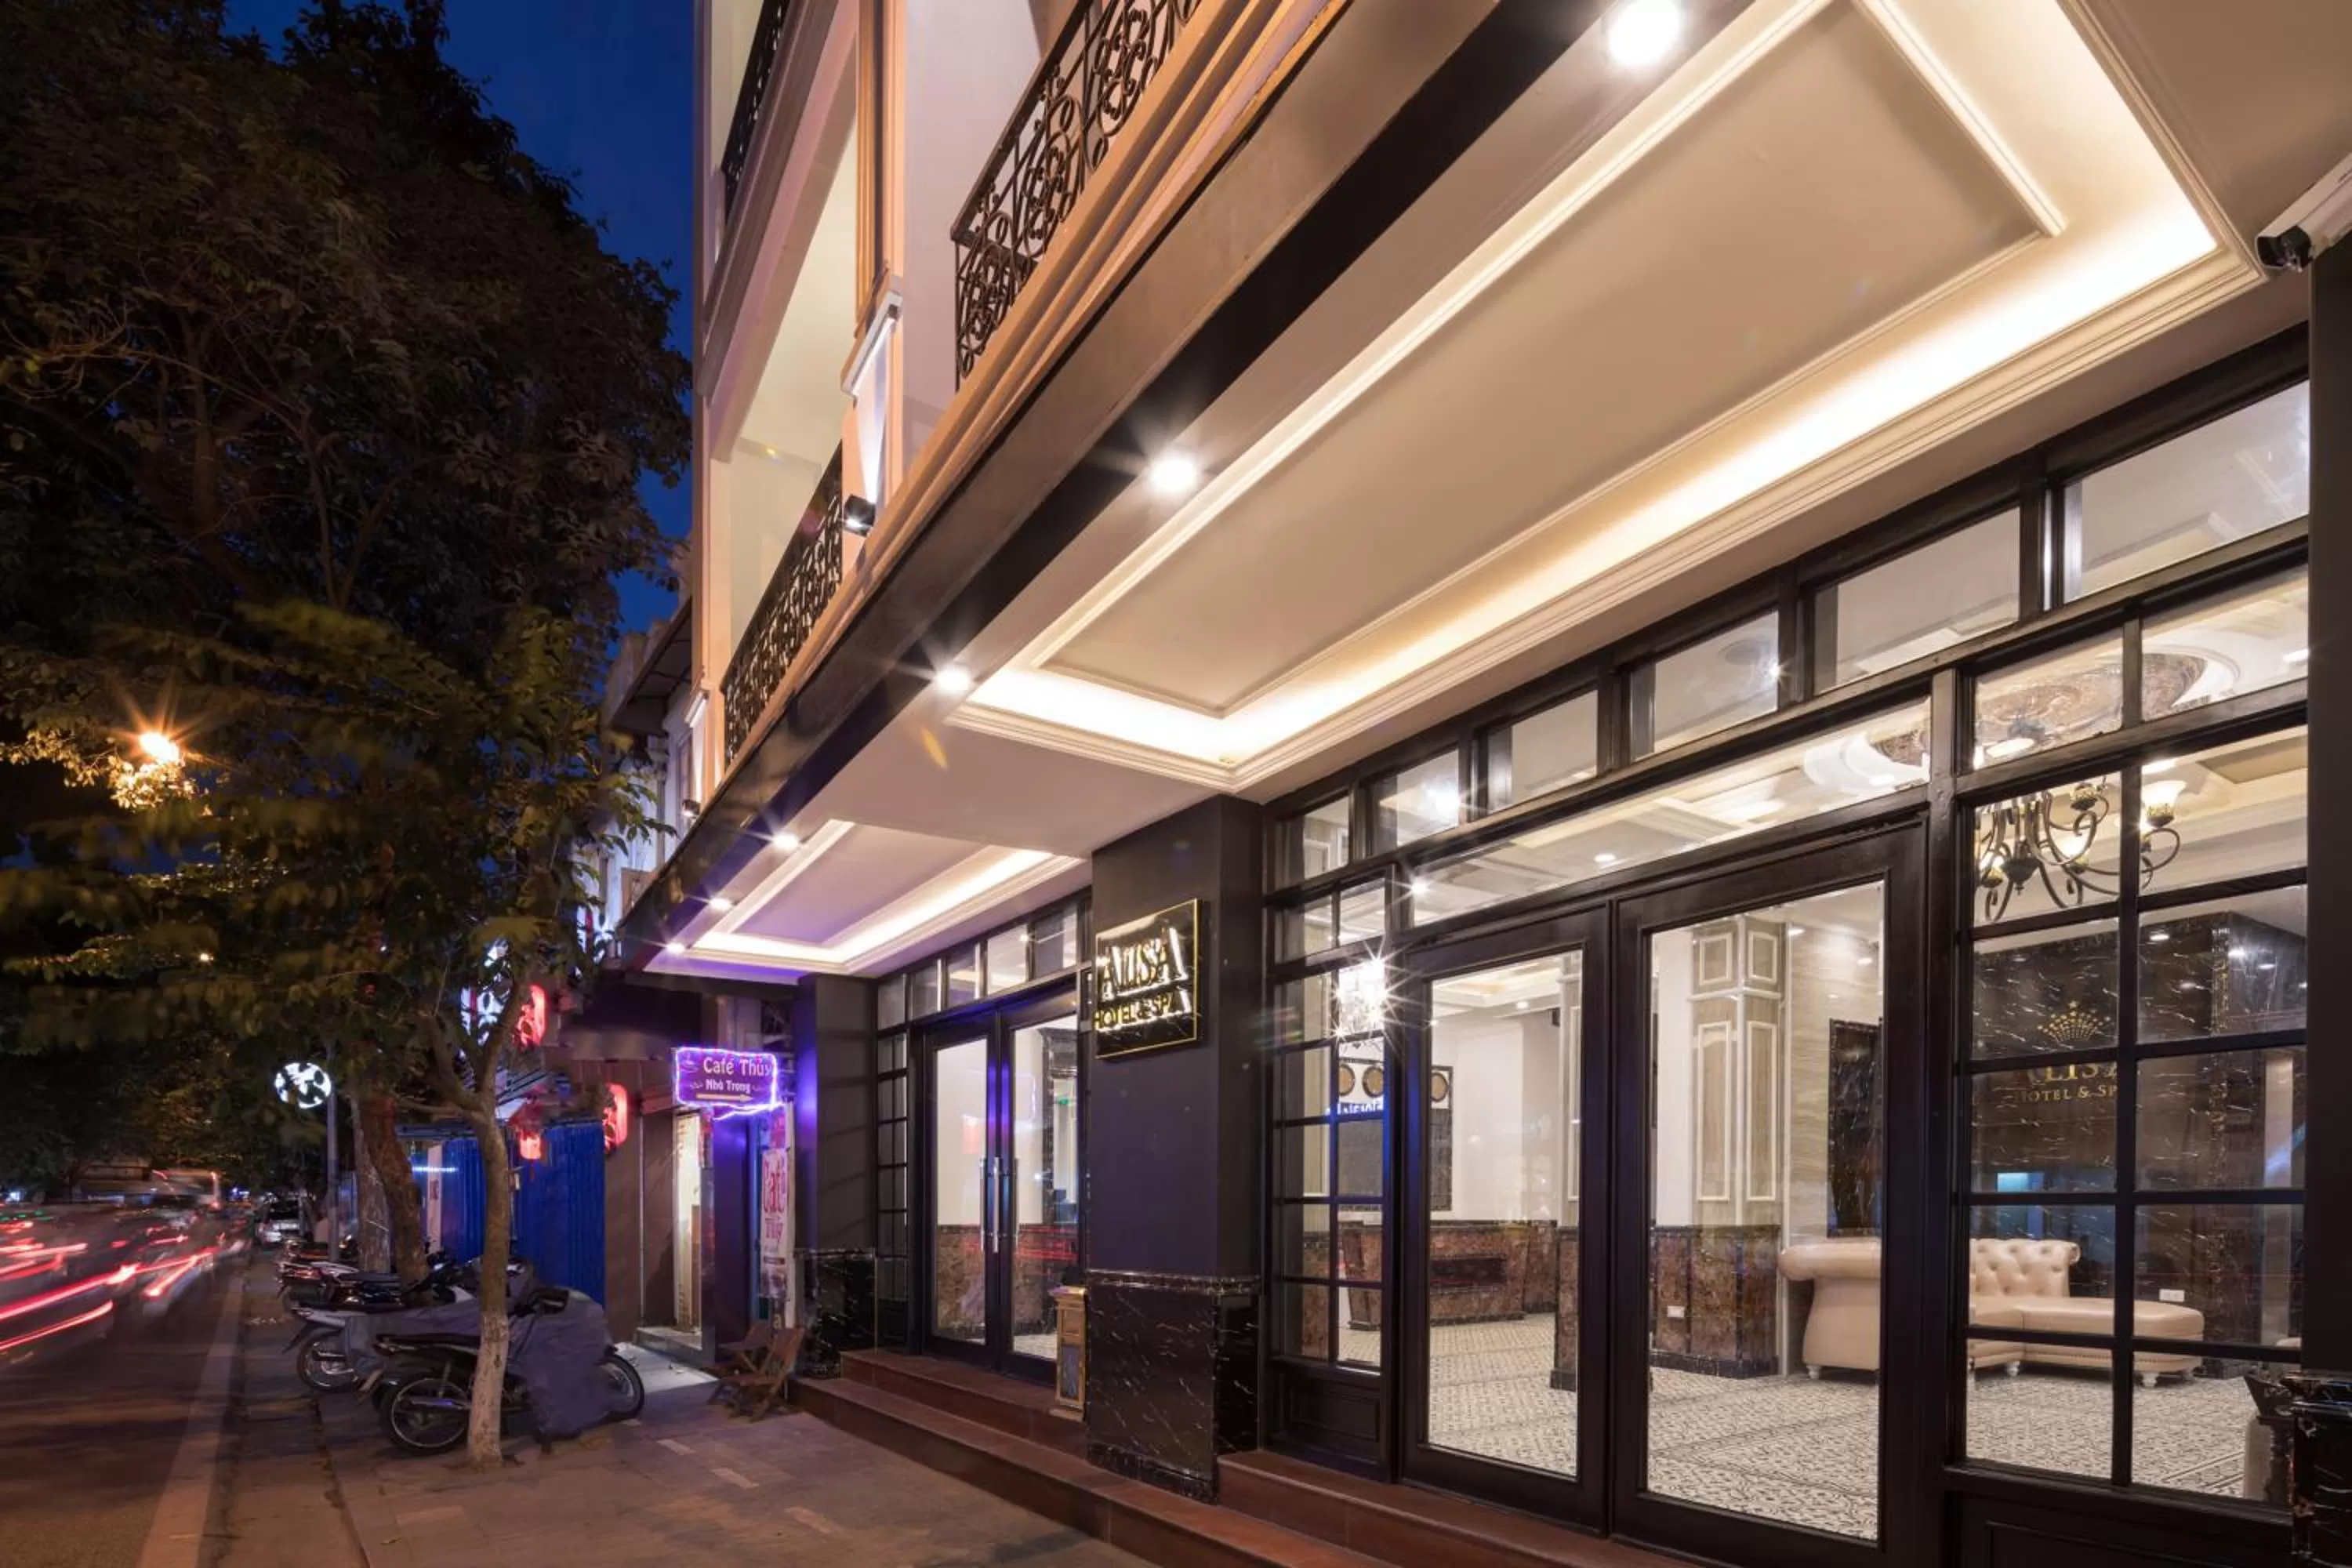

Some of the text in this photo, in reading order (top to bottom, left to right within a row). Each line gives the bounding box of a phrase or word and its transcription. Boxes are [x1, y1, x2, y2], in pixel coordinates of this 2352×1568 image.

[1093, 1003, 1137, 1029] HOTEL
[703, 1056, 735, 1075] Café
[2014, 1084, 2117, 1102] HOTEL & SP
